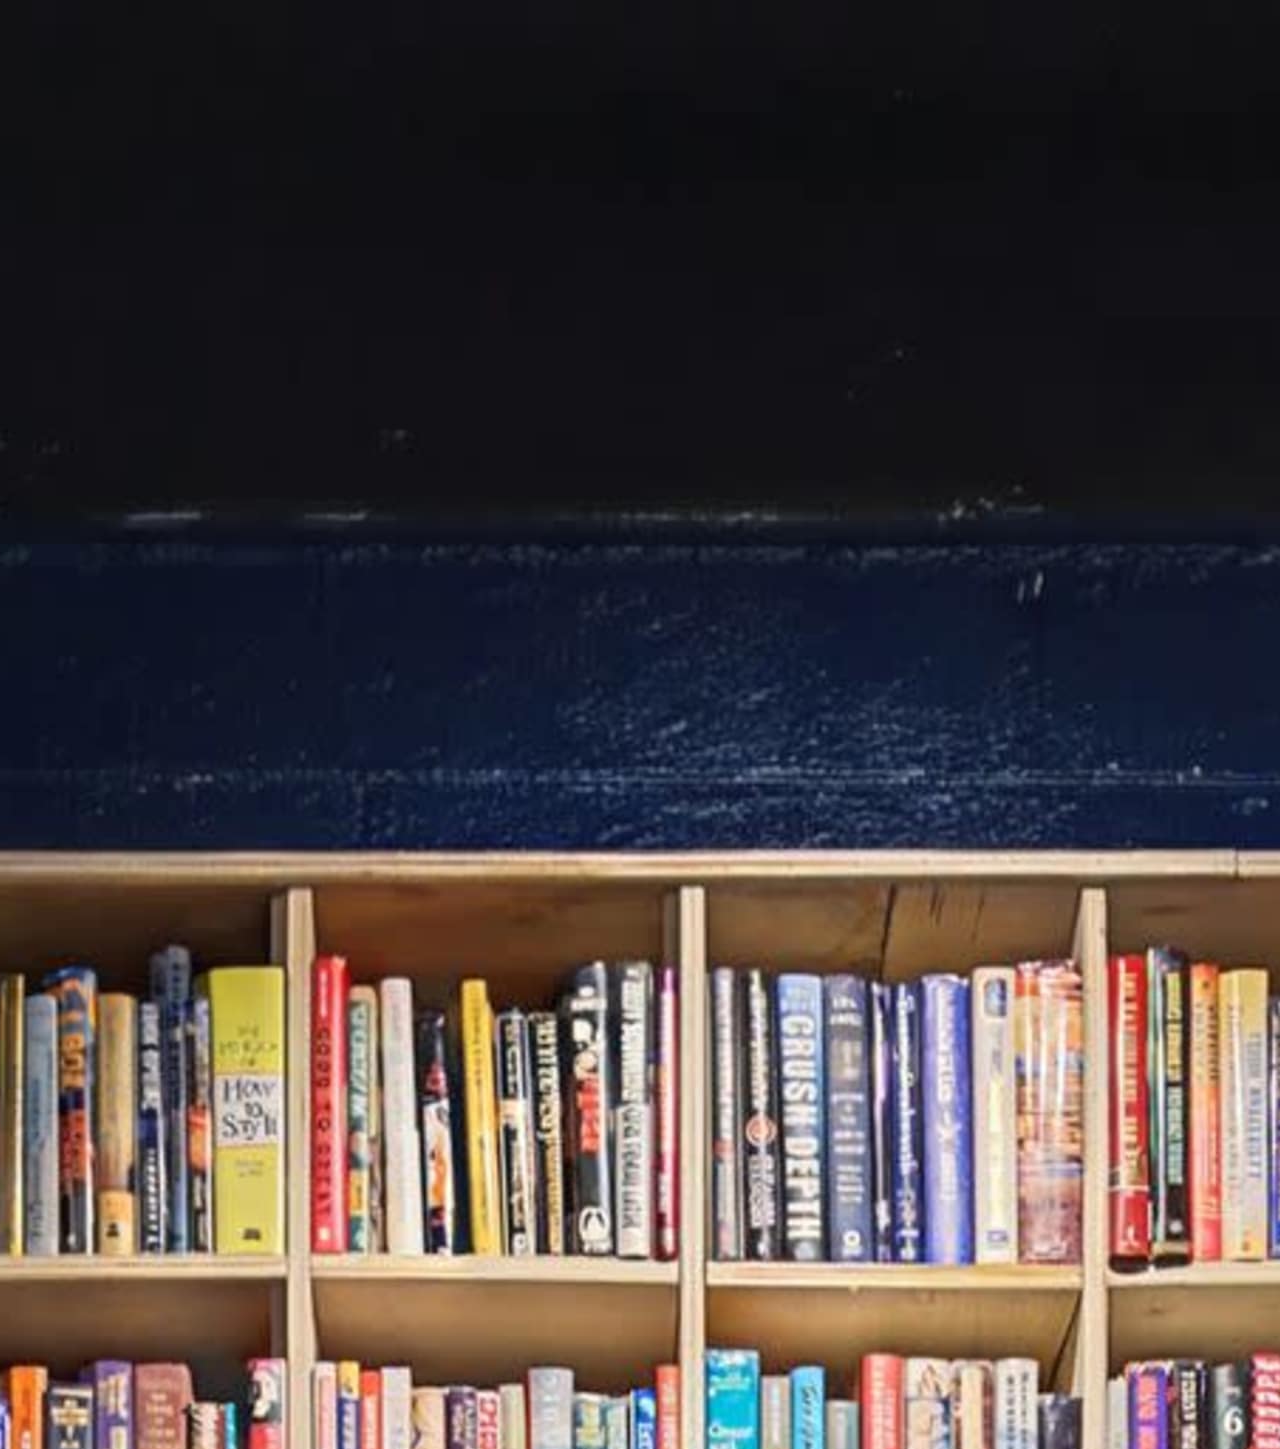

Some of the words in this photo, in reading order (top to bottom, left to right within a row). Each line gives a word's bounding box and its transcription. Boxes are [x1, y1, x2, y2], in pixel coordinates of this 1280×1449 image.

[317, 1026, 331, 1088] GOOD
[785, 1013, 817, 1126] CRUSH
[317, 1101, 331, 1132] TO
[317, 1143, 331, 1218] GREAT
[786, 1135, 820, 1240] DEPTH
